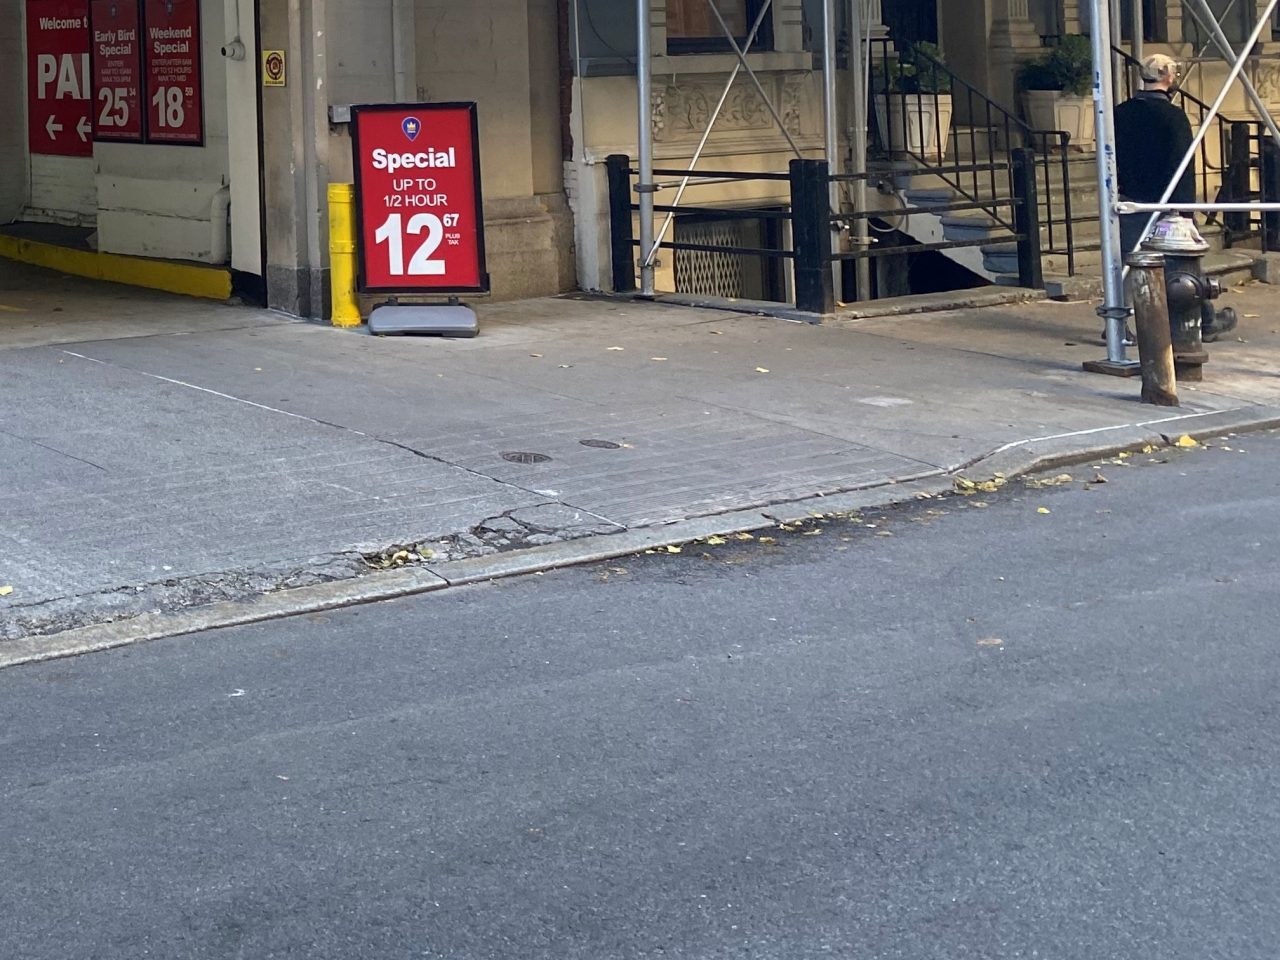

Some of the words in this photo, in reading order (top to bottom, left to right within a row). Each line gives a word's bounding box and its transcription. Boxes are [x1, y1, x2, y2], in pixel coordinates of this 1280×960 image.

[40, 16, 81, 29] Welcome
[95, 30, 116, 44] Early
[118, 28, 135, 41] Bird
[150, 26, 192, 39] Weekend
[100, 43, 132, 58] Special
[154, 41, 189, 56] Special
[98, 87, 129, 127] 25
[153, 86, 185, 128] 18
[372, 147, 456, 173] Special
[393, 179, 413, 191] UP
[416, 178, 437, 191] TO
[384, 195, 402, 207] 1/2
[405, 194, 448, 206] HOUR
[375, 213, 446, 276] 12
[443, 213, 459, 227] 67
